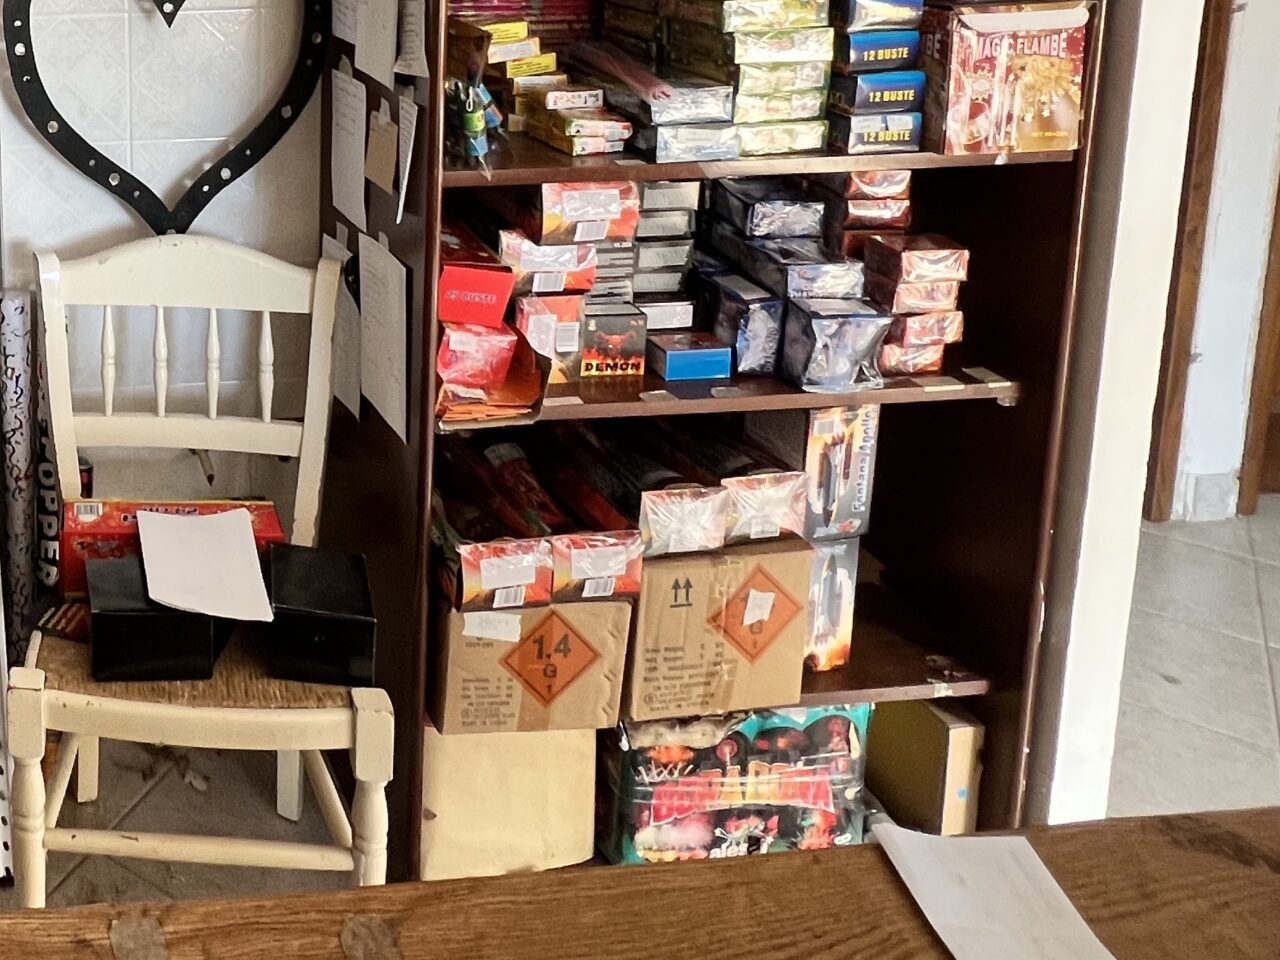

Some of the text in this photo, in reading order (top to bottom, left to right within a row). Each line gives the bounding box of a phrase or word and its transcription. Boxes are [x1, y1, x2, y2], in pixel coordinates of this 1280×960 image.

[863, 46, 909, 61] 12 BUSTE
[1017, 33, 1068, 59] FLAMBE
[869, 88, 915, 102] 12 BUSTE
[863, 128, 911, 142] 12 BUSTE
[584, 360, 641, 372] DEMON
[532, 634, 571, 660] 1.4
[543, 663, 558, 679] G
